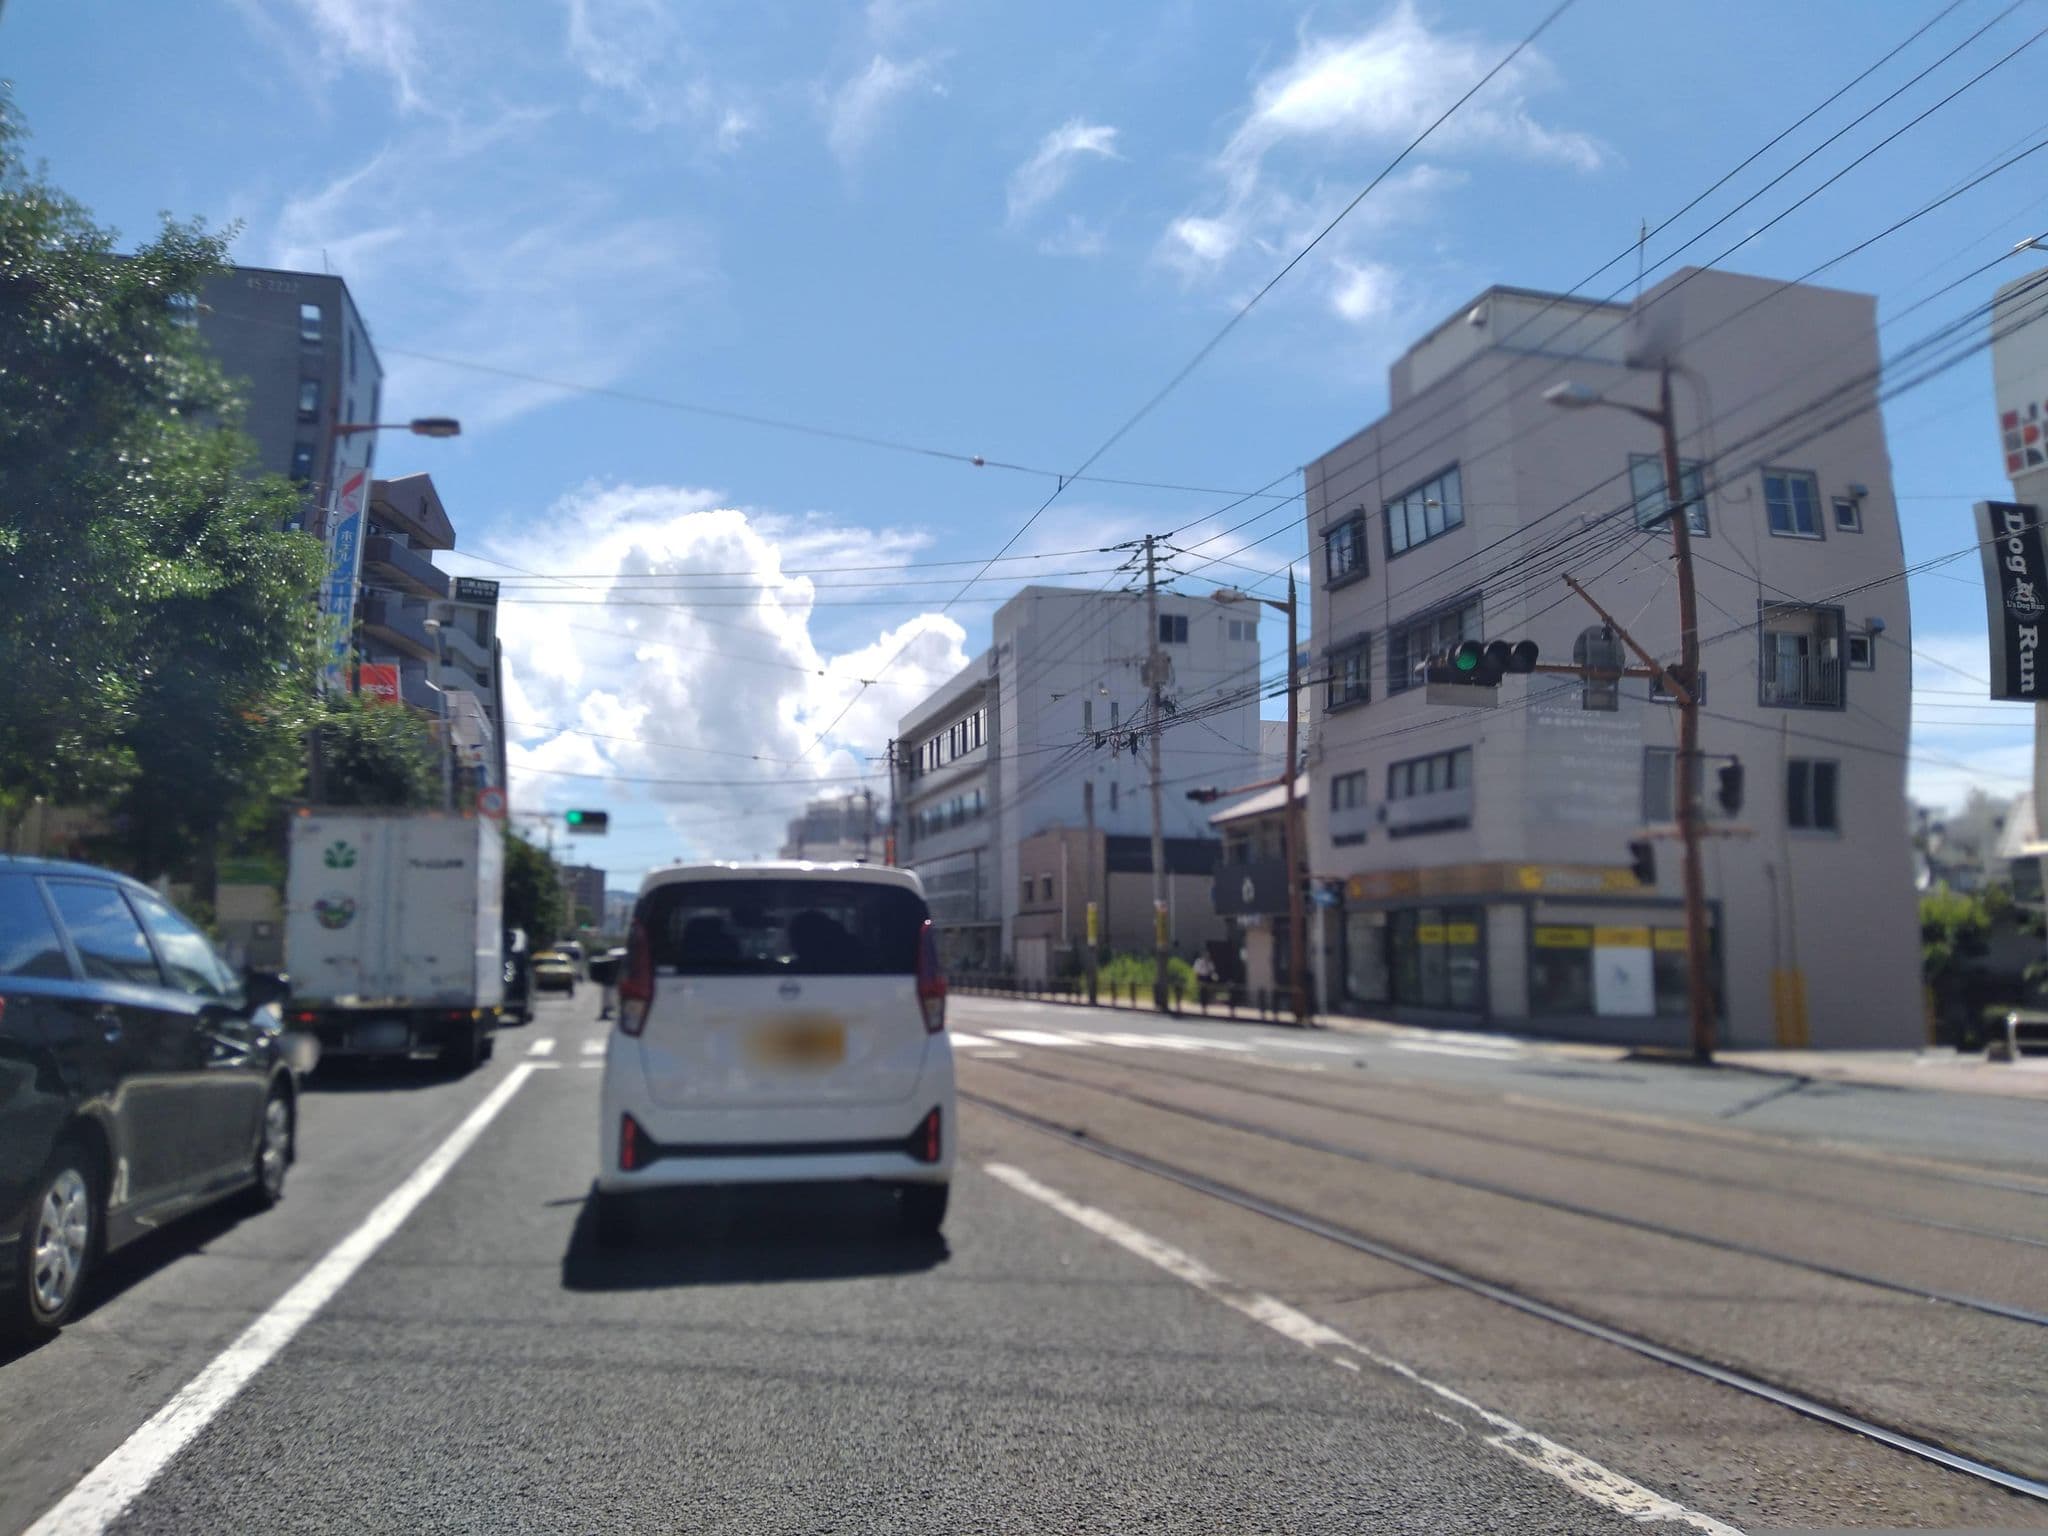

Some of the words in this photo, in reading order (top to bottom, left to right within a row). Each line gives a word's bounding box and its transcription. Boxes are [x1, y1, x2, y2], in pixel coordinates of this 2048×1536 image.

[2004, 511, 2026, 574] Dog
[2018, 625, 2038, 693] Run
[2016, 602, 2030, 611] Dog
